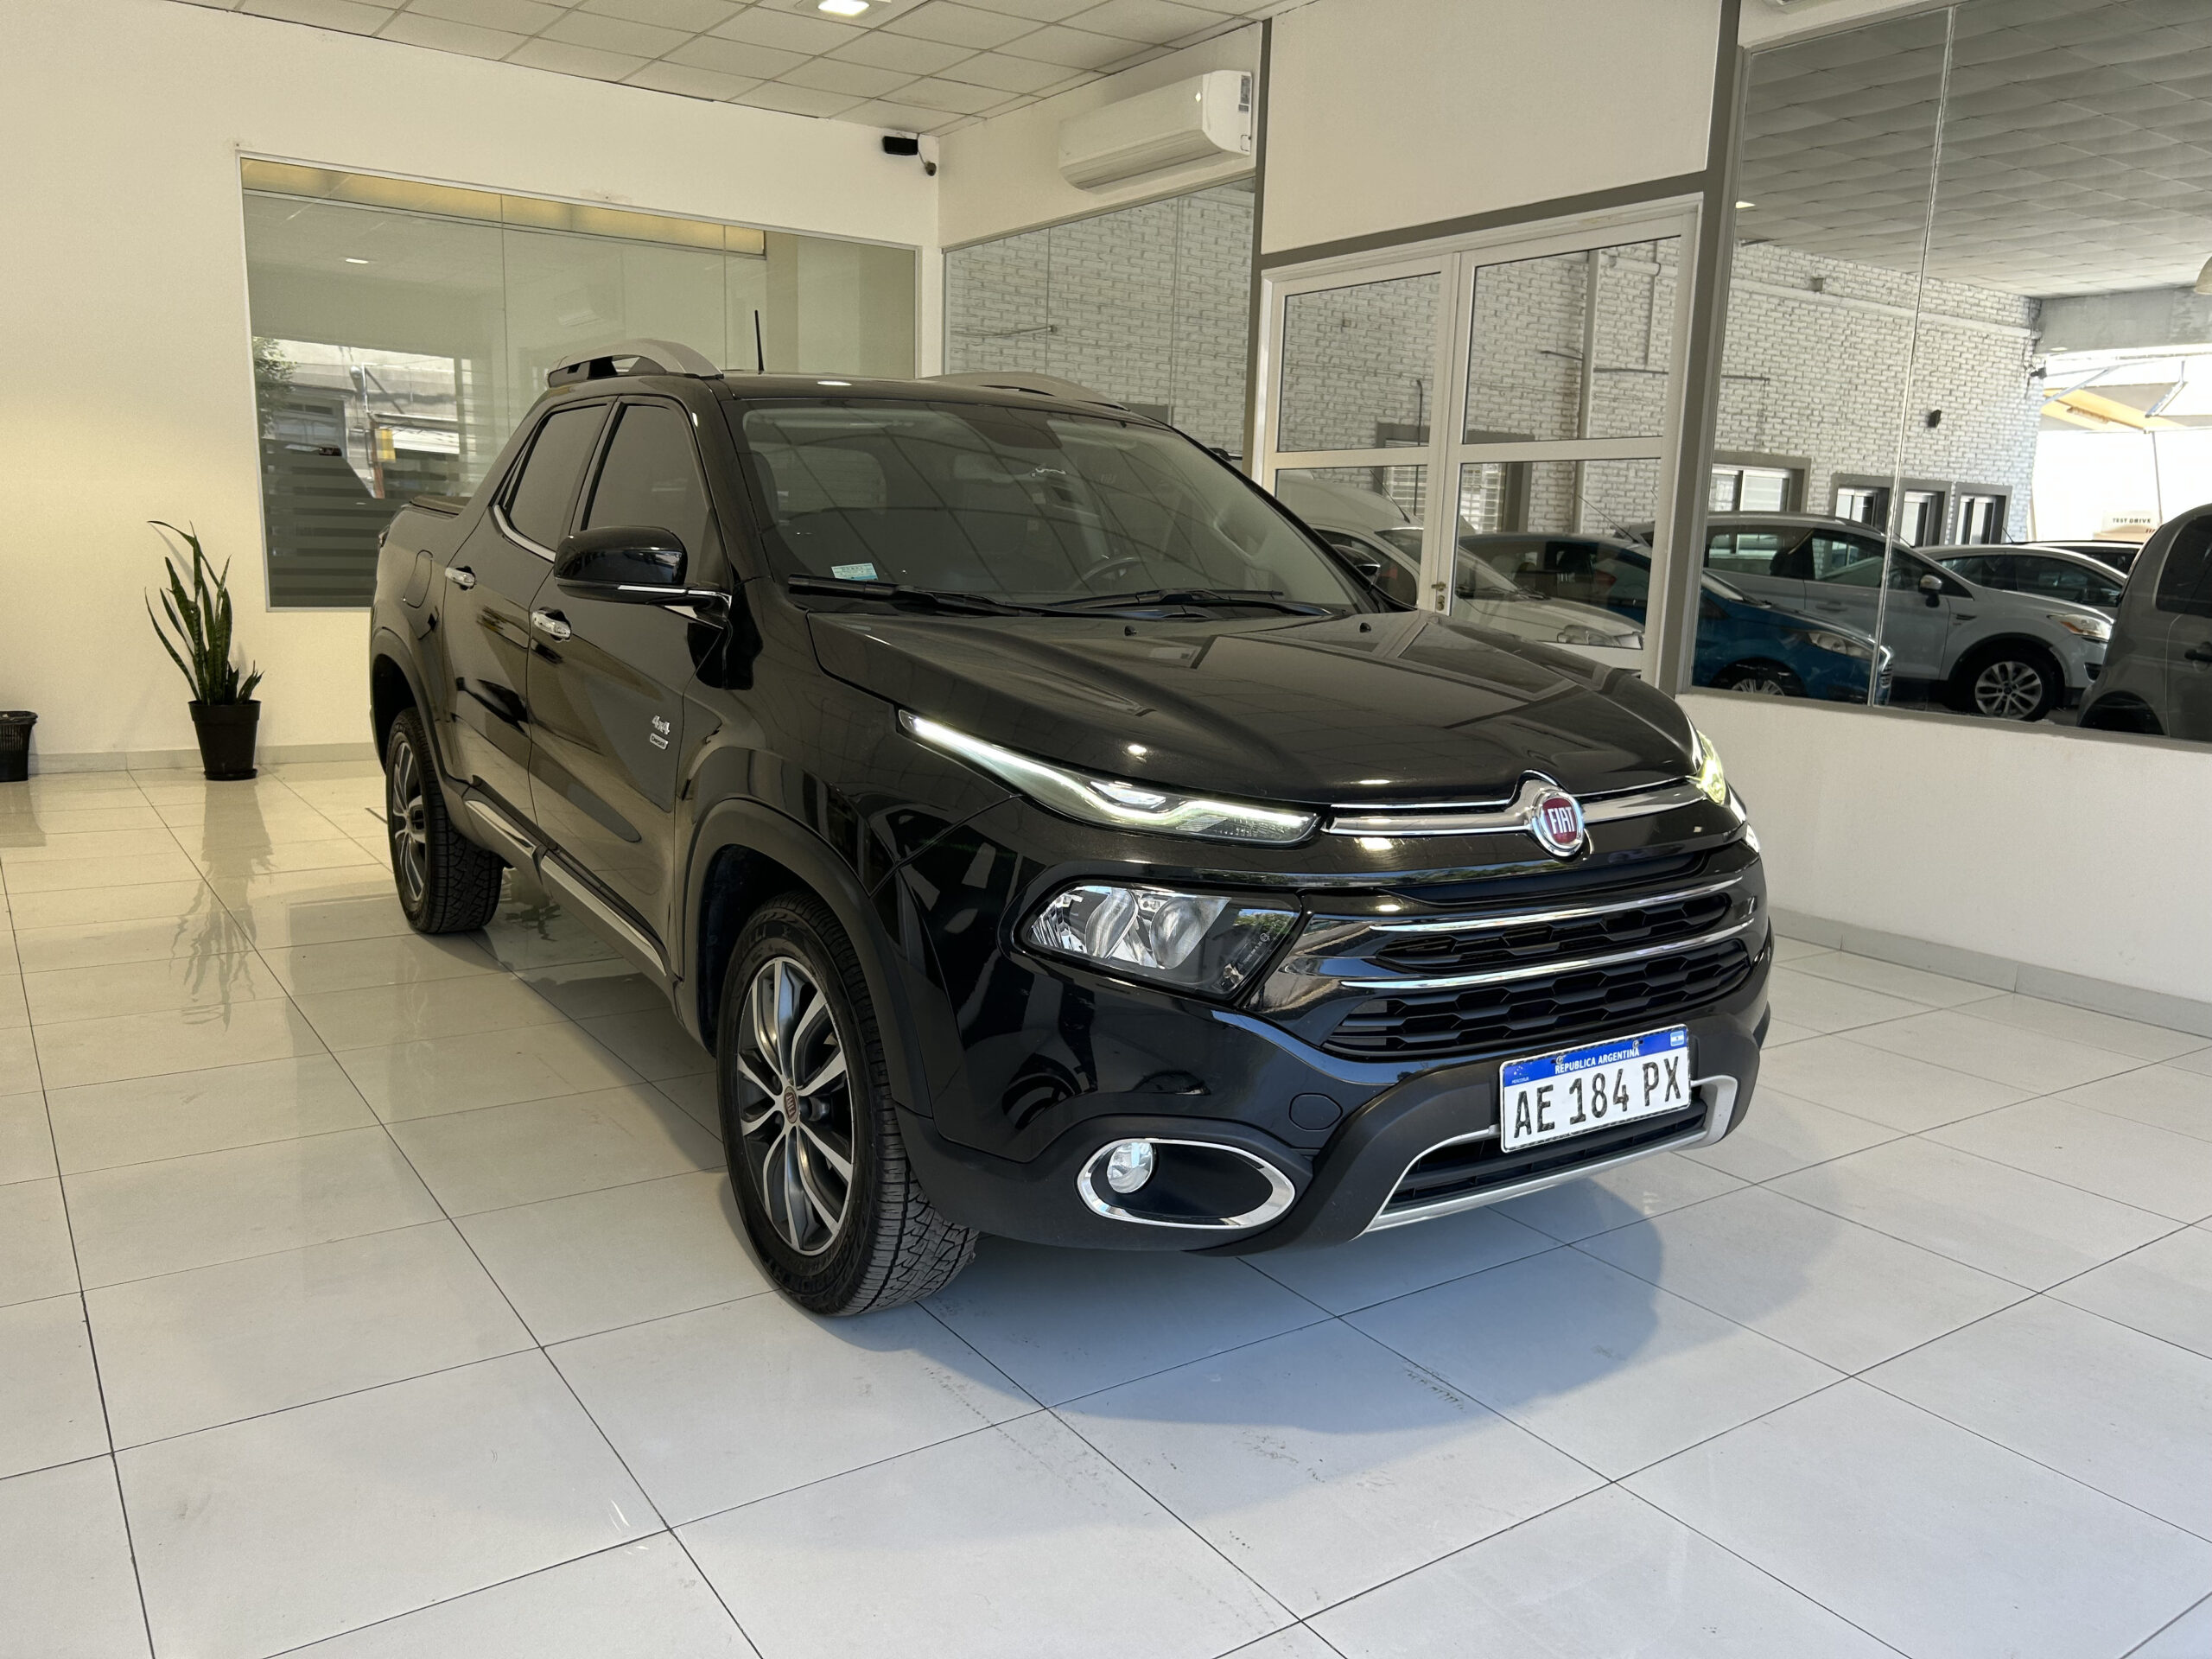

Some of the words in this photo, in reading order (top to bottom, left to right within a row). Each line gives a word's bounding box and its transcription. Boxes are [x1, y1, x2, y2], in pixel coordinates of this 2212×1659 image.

[1548, 806, 1575, 835] FIAT
[1554, 1057, 1597, 1075] REPUBLICA
[1598, 1047, 1640, 1065] ARGENTINA
[1514, 1084, 1555, 1139] AE
[1568, 1068, 1630, 1125] 184
[1642, 1055, 1681, 1107] PX
